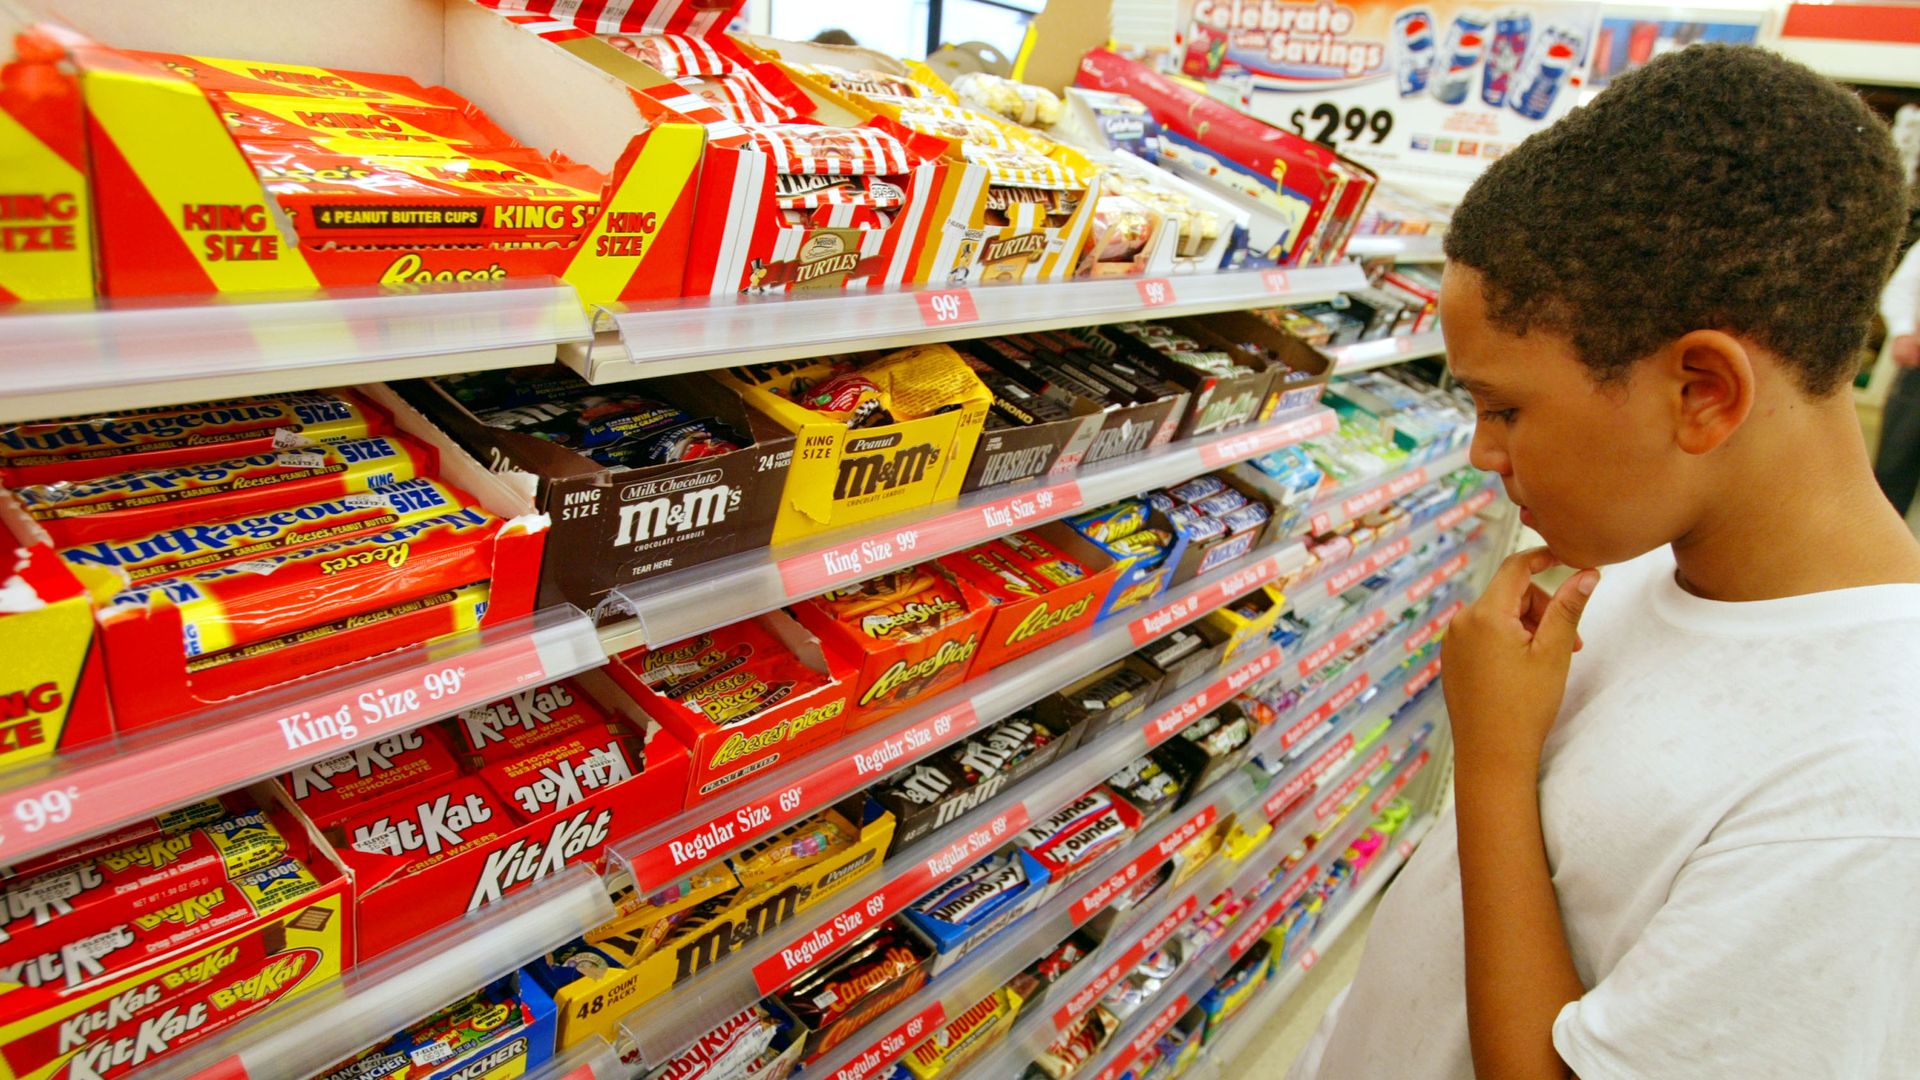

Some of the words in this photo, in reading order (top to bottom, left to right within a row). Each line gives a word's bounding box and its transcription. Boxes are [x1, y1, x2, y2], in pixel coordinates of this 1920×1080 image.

[1194, 0, 1353, 35] Celebrate
[1269, 31, 1384, 75] Savings
[247, 68, 353, 89] KING
[293, 110, 403, 132] KING
[182, 203, 266, 232] KING
[321, 210, 331, 224] 4
[334, 209, 388, 224] PEANUT
[391, 209, 443, 223] BUTTER
[445, 209, 477, 223] CUPS
[493, 205, 565, 230] KING
[605, 211, 656, 235] KING
[206, 234, 279, 262] SIZE
[596, 235, 643, 257] SIZE
[987, 235, 1045, 262] TURTLES
[796, 254, 859, 283] TURTLES
[293, 401, 353, 425] SIZE
[959, 414, 973, 428] 24
[337, 438, 399, 463] SIZE
[802, 448, 832, 460] SIZE
[805, 435, 834, 447] KING
[853, 435, 895, 452] Peanut
[757, 453, 775, 473] 24
[774, 459, 792, 469] PACKS
[126, 494, 168, 508] PEANUTS
[180, 486, 222, 499] CARAMEL
[280, 470, 312, 485] PEANUT
[313, 463, 343, 477] BUTTER
[367, 473, 395, 489] KING
[627, 484, 658, 500] Milk
[659, 471, 718, 492] Chocolate
[389, 488, 446, 514] SIZE
[562, 502, 600, 521] SIZE
[564, 488, 602, 507] KING
[846, 495, 881, 507] CHOCOLATE
[982, 506, 1013, 529] King
[1011, 497, 1037, 520] Size
[179, 553, 222, 569] PEANUTS
[233, 541, 275, 556] CARAMEL
[332, 522, 363, 537] PEANUT
[365, 515, 395, 529] BUTTER
[634, 535, 675, 553] CHOCOLATE
[676, 529, 706, 543] CANDIES
[319, 542, 410, 576] Reese's
[632, 563, 652, 576] TEAR
[653, 558, 674, 571] HERE
[822, 548, 862, 576] King
[861, 539, 893, 565] Size
[296, 624, 337, 642] CARAMEL
[392, 602, 422, 617] PEANUT
[423, 593, 453, 608] BUTTER
[1004, 592, 1095, 646] Reese's
[279, 704, 358, 750] King
[358, 688, 421, 726] Size
[423, 667, 466, 701] 99¢
[701, 679, 769, 723] pieces
[508, 728, 539, 745] CRISP
[540, 712, 582, 732] WAFERS
[525, 718, 586, 744] CHOCOLATE
[708, 719, 791, 770] Reese's
[788, 697, 846, 740] pieces
[503, 745, 568, 774] CHOCOLATE
[555, 744, 586, 761] CRISP
[853, 737, 905, 776] Regular
[904, 727, 932, 752] Size
[335, 775, 375, 796] CRISP
[376, 758, 429, 782] WAFERS
[355, 764, 433, 795] CHOCOLATE
[508, 758, 555, 779] WAFERS
[669, 820, 735, 866] Regular
[739, 796, 772, 834] Size
[406, 852, 445, 874] CRISP
[450, 831, 499, 859] WAFERS
[466, 808, 614, 914] KitKat
[928, 844, 970, 878] Regular
[968, 830, 992, 852] Size
[826, 855, 870, 884] Peanut
[781, 929, 834, 970] Regular
[833, 912, 864, 938] Size
[59, 982, 162, 1055] KitKat
[161, 946, 240, 990] BigKat
[575, 995, 606, 1022] 48
[607, 974, 640, 998] COUNT
[606, 985, 638, 1007] PACKS
[69, 1001, 209, 1080] KitKat
[209, 954, 307, 1011] BigKat
[414, 1041, 448, 1057] 7-ELEVEN
[837, 1050, 881, 1080] Regular
[881, 1034, 906, 1058] Size
